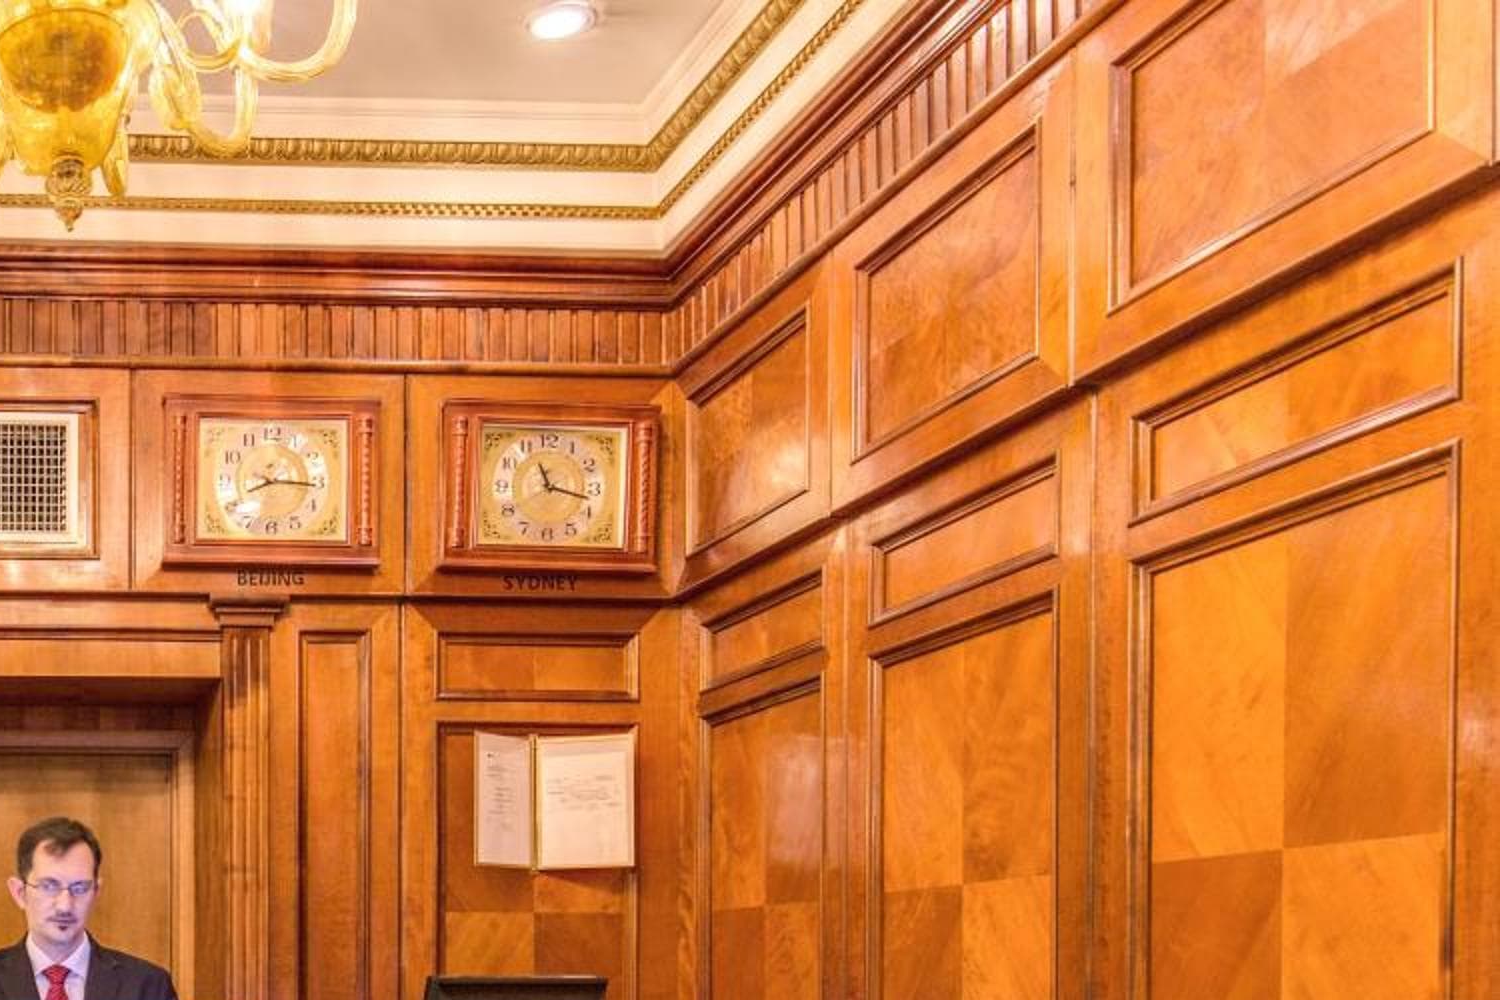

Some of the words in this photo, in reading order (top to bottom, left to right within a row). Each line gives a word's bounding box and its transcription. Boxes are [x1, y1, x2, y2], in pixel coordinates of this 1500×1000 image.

[243, 434, 255, 447] 11
[263, 427, 282, 441] 12
[539, 434, 559, 448] 12
[520, 440, 532, 453] 11
[569, 441, 575, 454] 1
[225, 451, 241, 465] 10
[583, 458, 595, 472] 2
[312, 477, 325, 490] 3
[495, 479, 509, 493] 9
[587, 482, 601, 497] 3
[305, 499, 317, 513] 4
[502, 503, 515, 517] 8
[580, 505, 591, 519] 4
[242, 516, 253, 529] 7
[265, 521, 278, 535] 6
[289, 516, 302, 530] 5
[518, 521, 530, 536] 7
[564, 522, 577, 536] 5
[541, 527, 553, 541] 6
[237, 568, 305, 586] BEIJING
[502, 575, 578, 592] SYDNEY
